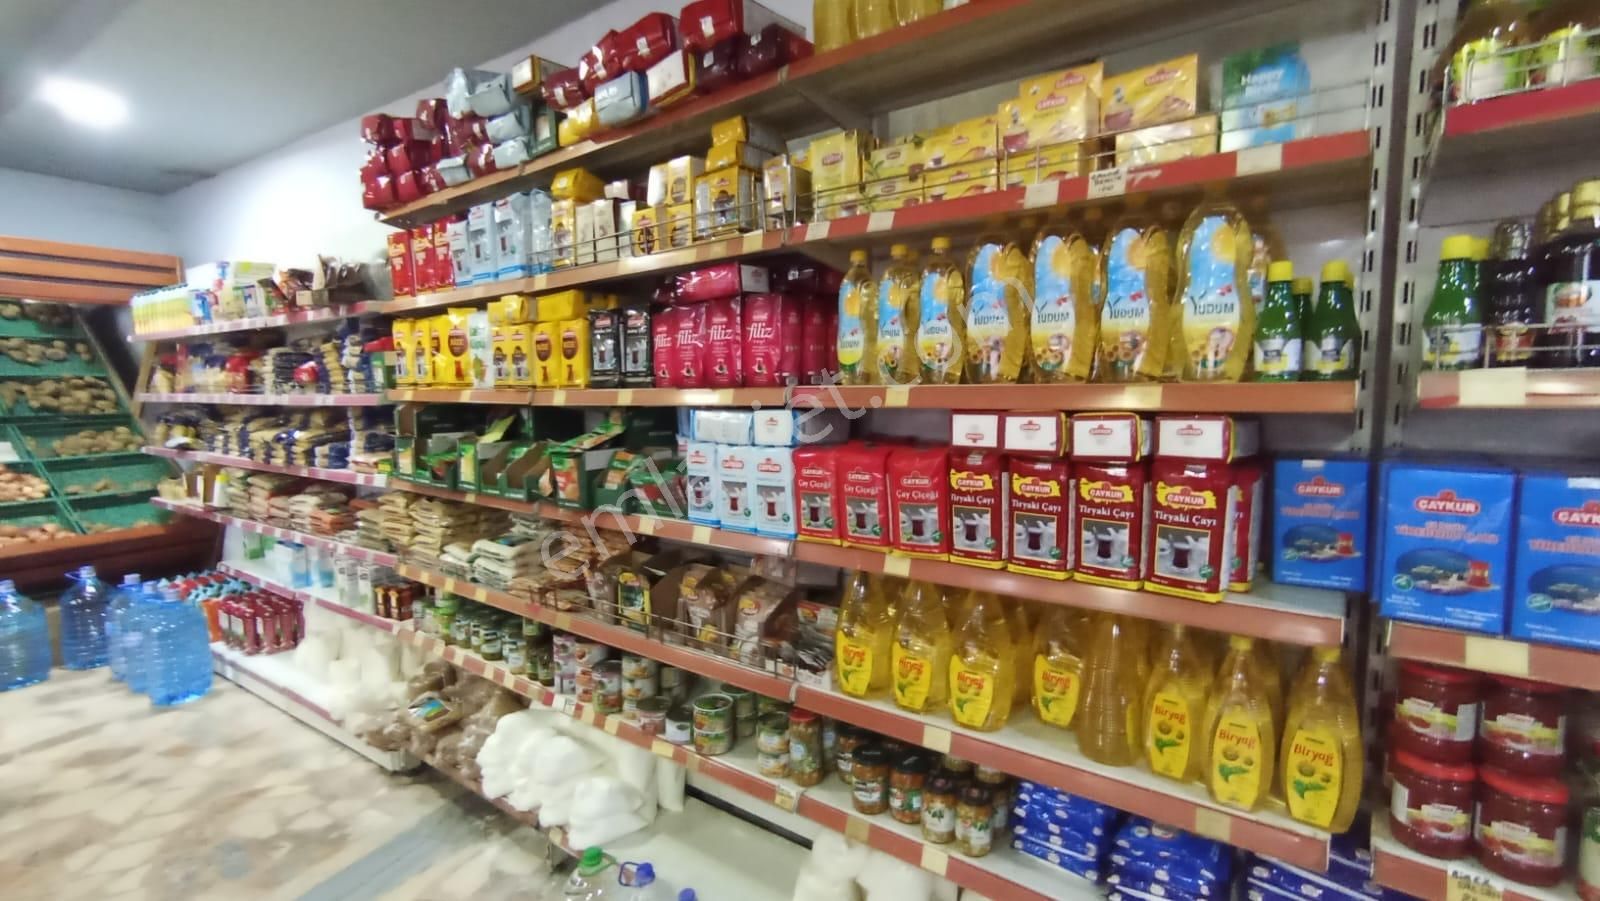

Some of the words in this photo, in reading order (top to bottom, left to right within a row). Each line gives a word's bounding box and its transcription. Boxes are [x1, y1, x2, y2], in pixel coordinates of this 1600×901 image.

[1035, 301, 1070, 323] YUDUM
[1107, 295, 1145, 319] YUDUM
[1190, 290, 1235, 315] YUDUM
[675, 329, 699, 348] filiz
[707, 324, 733, 344] filiz
[745, 322, 773, 343] filiz
[1012, 499, 1040, 511] Tiryaki
[1041, 502, 1062, 513] Çayı
[1079, 505, 1111, 518] Tiryaki
[1112, 507, 1135, 519] Çayı
[1154, 510, 1189, 525] Tiryaki
[1192, 513, 1217, 527] Çayı
[1293, 743, 1334, 767] Biryağ
